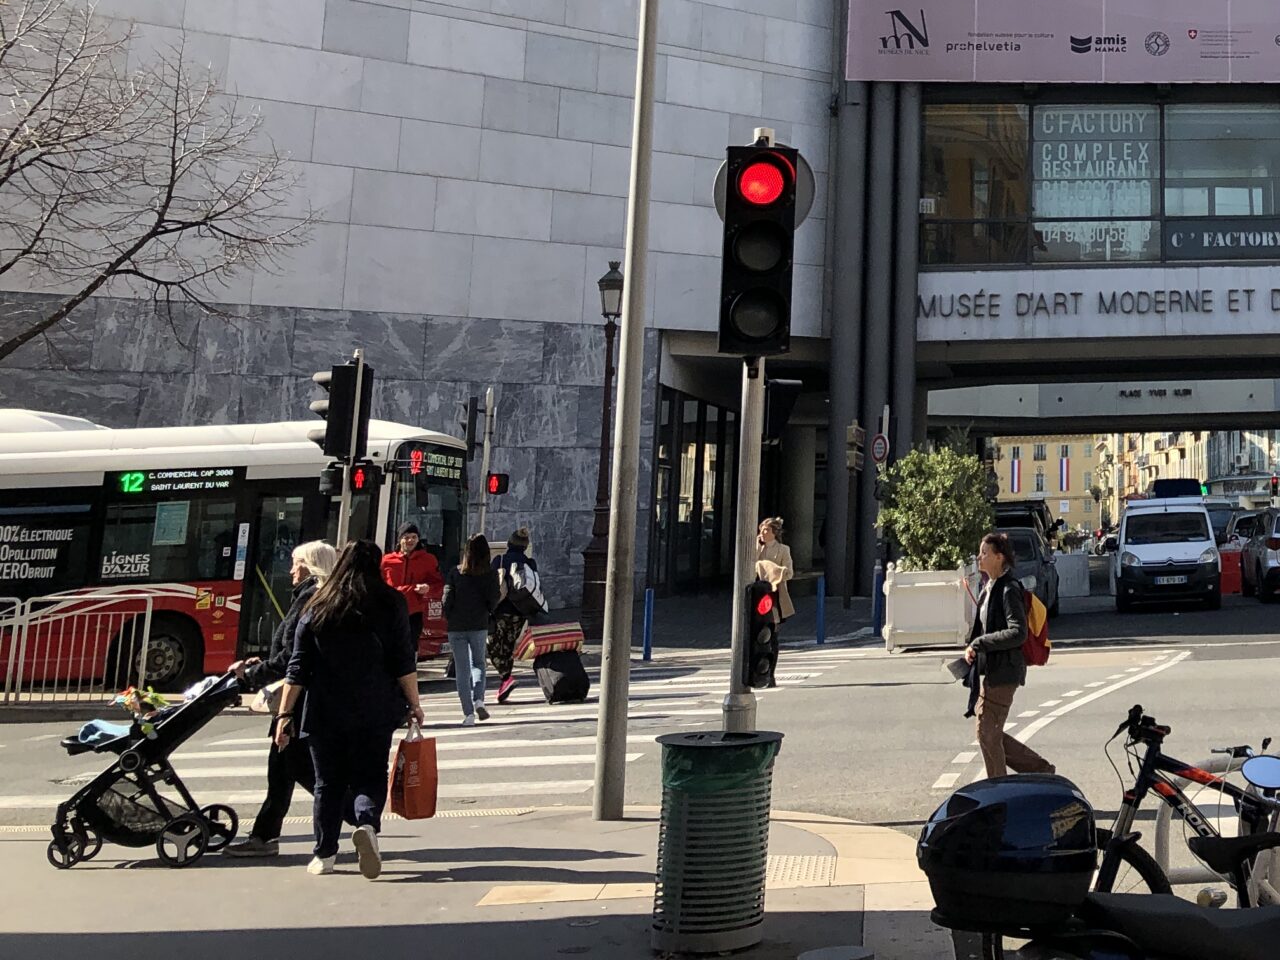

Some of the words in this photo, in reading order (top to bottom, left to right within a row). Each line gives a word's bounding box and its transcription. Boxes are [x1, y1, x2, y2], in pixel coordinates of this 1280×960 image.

[1095, 34, 1126, 45] amis
[1042, 143, 1149, 161] COMPLEX
[1042, 160, 1149, 178] RESTAURANT
[917, 289, 1000, 319] MUSÉE
[1016, 292, 1083, 317] D'ART
[1098, 290, 1213, 315] MODERNE
[1228, 288, 1255, 312] ET
[157, 471, 199, 479] COMMERCIAL
[200, 469, 214, 477] CAP
[121, 472, 145, 492] 12
[150, 483, 172, 491] SAINT
[172, 482, 203, 490] LAURENT
[215, 480, 230, 488] VAR
[20, 527, 73, 542] ÉLECTRIQUE
[103, 551, 151, 565] LIGNES
[102, 563, 149, 574] D'AZUR
